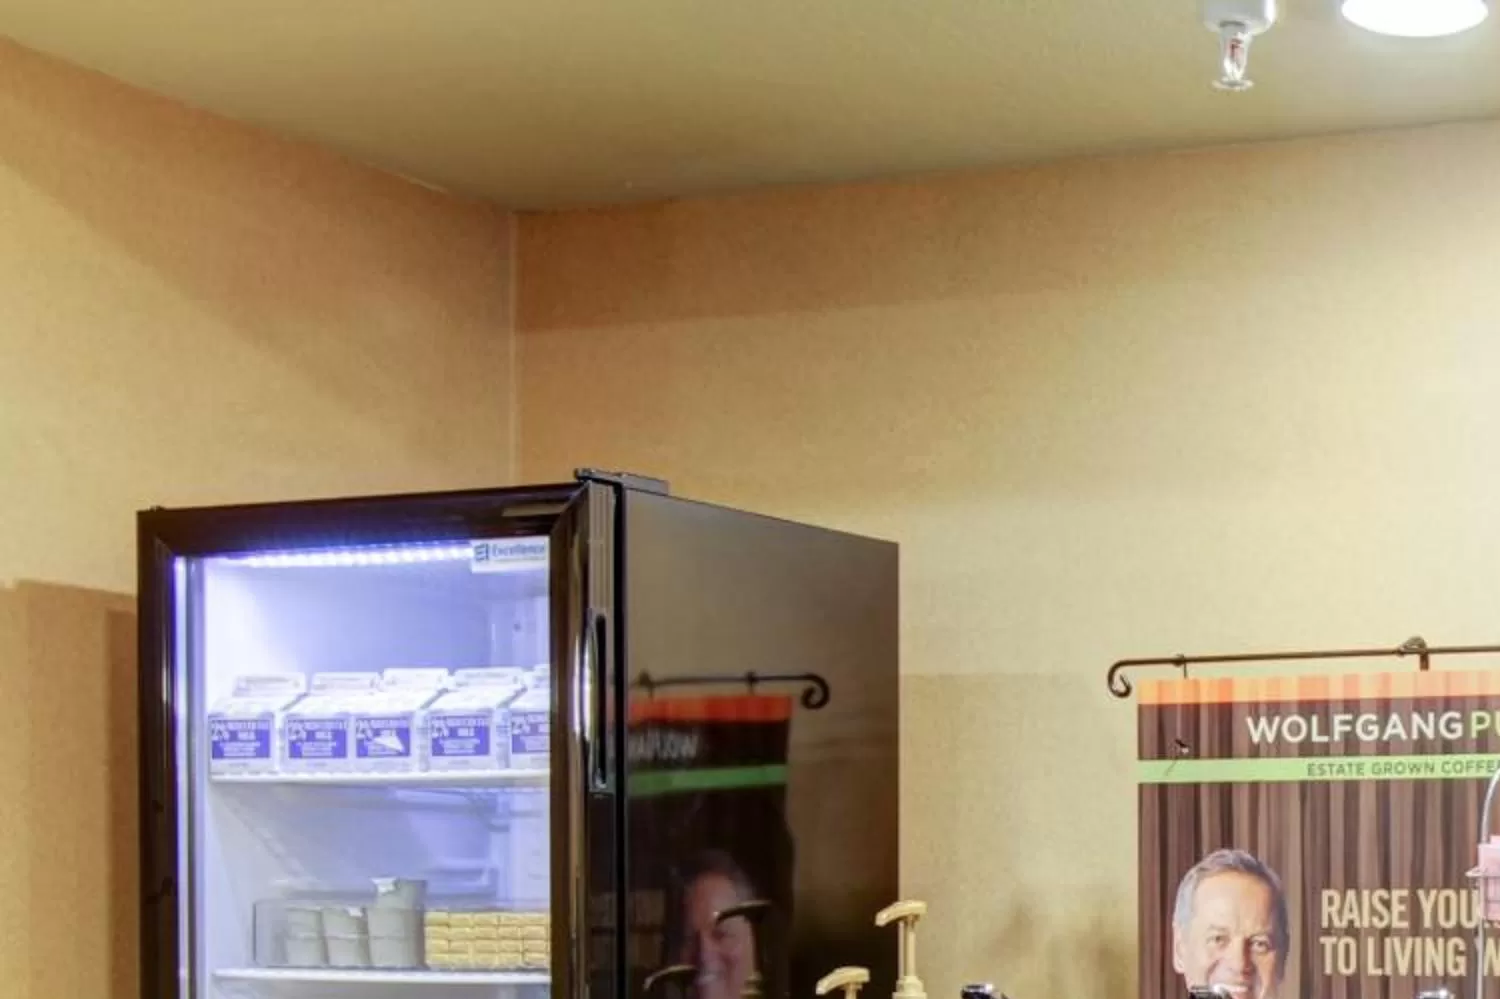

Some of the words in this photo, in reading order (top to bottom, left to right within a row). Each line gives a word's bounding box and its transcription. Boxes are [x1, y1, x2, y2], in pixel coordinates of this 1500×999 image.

[1246, 711, 1464, 744] WOLFGANG
[1307, 761, 1366, 777] ESTATE
[1371, 760, 1435, 776] GROWN
[1320, 888, 1409, 929] RAISE
[1416, 888, 1486, 929] YOU
[1319, 936, 1358, 977] TO
[1366, 936, 1469, 977] LIVING
